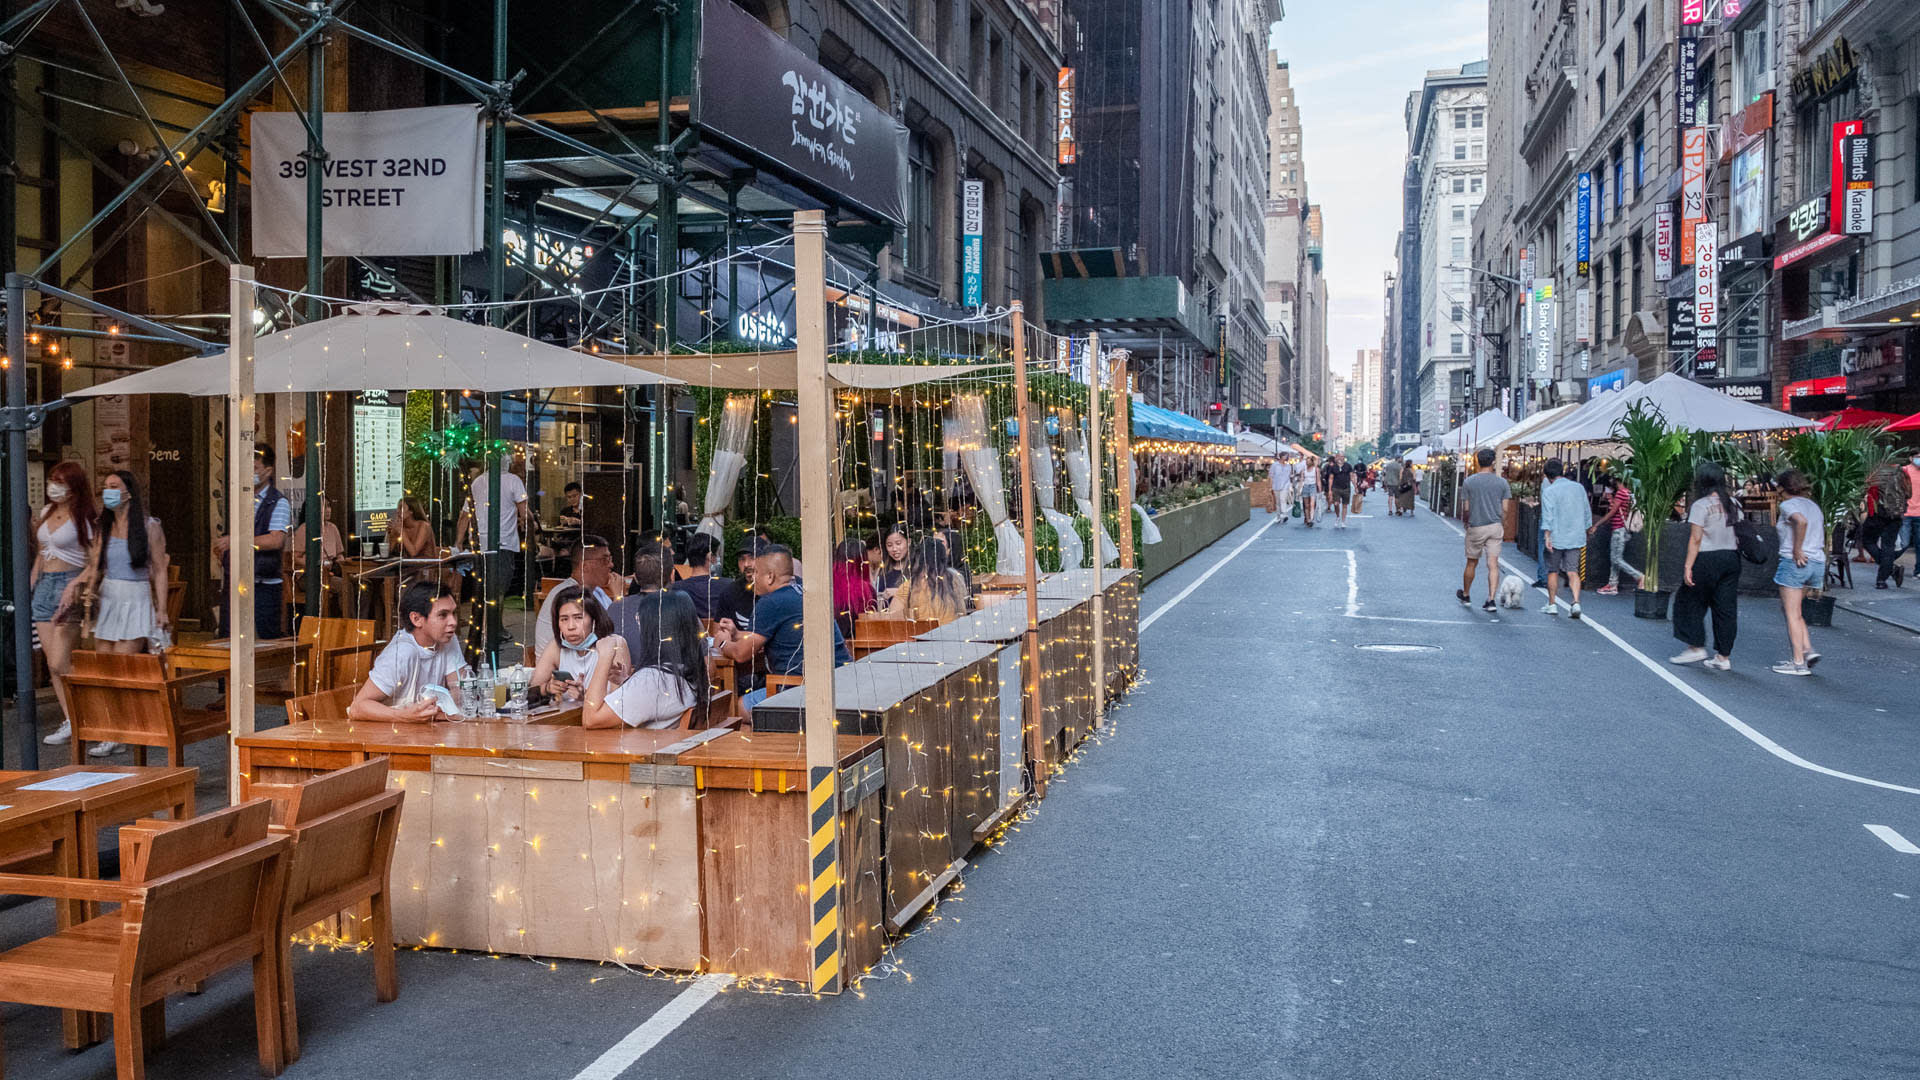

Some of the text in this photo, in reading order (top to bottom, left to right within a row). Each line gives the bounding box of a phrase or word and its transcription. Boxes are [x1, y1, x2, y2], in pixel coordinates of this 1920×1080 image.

[782, 71, 857, 145] 삼원가든
[1060, 91, 1073, 141] SPA
[279, 161, 307, 178] 39
[382, 158, 446, 177] 32ND
[1684, 134, 1704, 185] SPA
[1852, 138, 1868, 181] Billiards
[322, 188, 405, 207] STREET
[966, 184, 980, 232] 유럽안경
[1684, 191, 1702, 215] 32
[1790, 197, 1820, 241] 더큰집
[1852, 190, 1867, 231] Karaoke
[1578, 190, 1590, 259] K-TOWN SAUNA
[1658, 216, 1671, 261] 노래방
[972, 238, 981, 274] EUROPEAN
[1579, 262, 1588, 270] 24
[1697, 243, 1714, 323] 상하이몽
[1059, 340, 1067, 370] SPA
[1537, 303, 1550, 371] Bank of Hope
[1726, 385, 1763, 397] MONG
